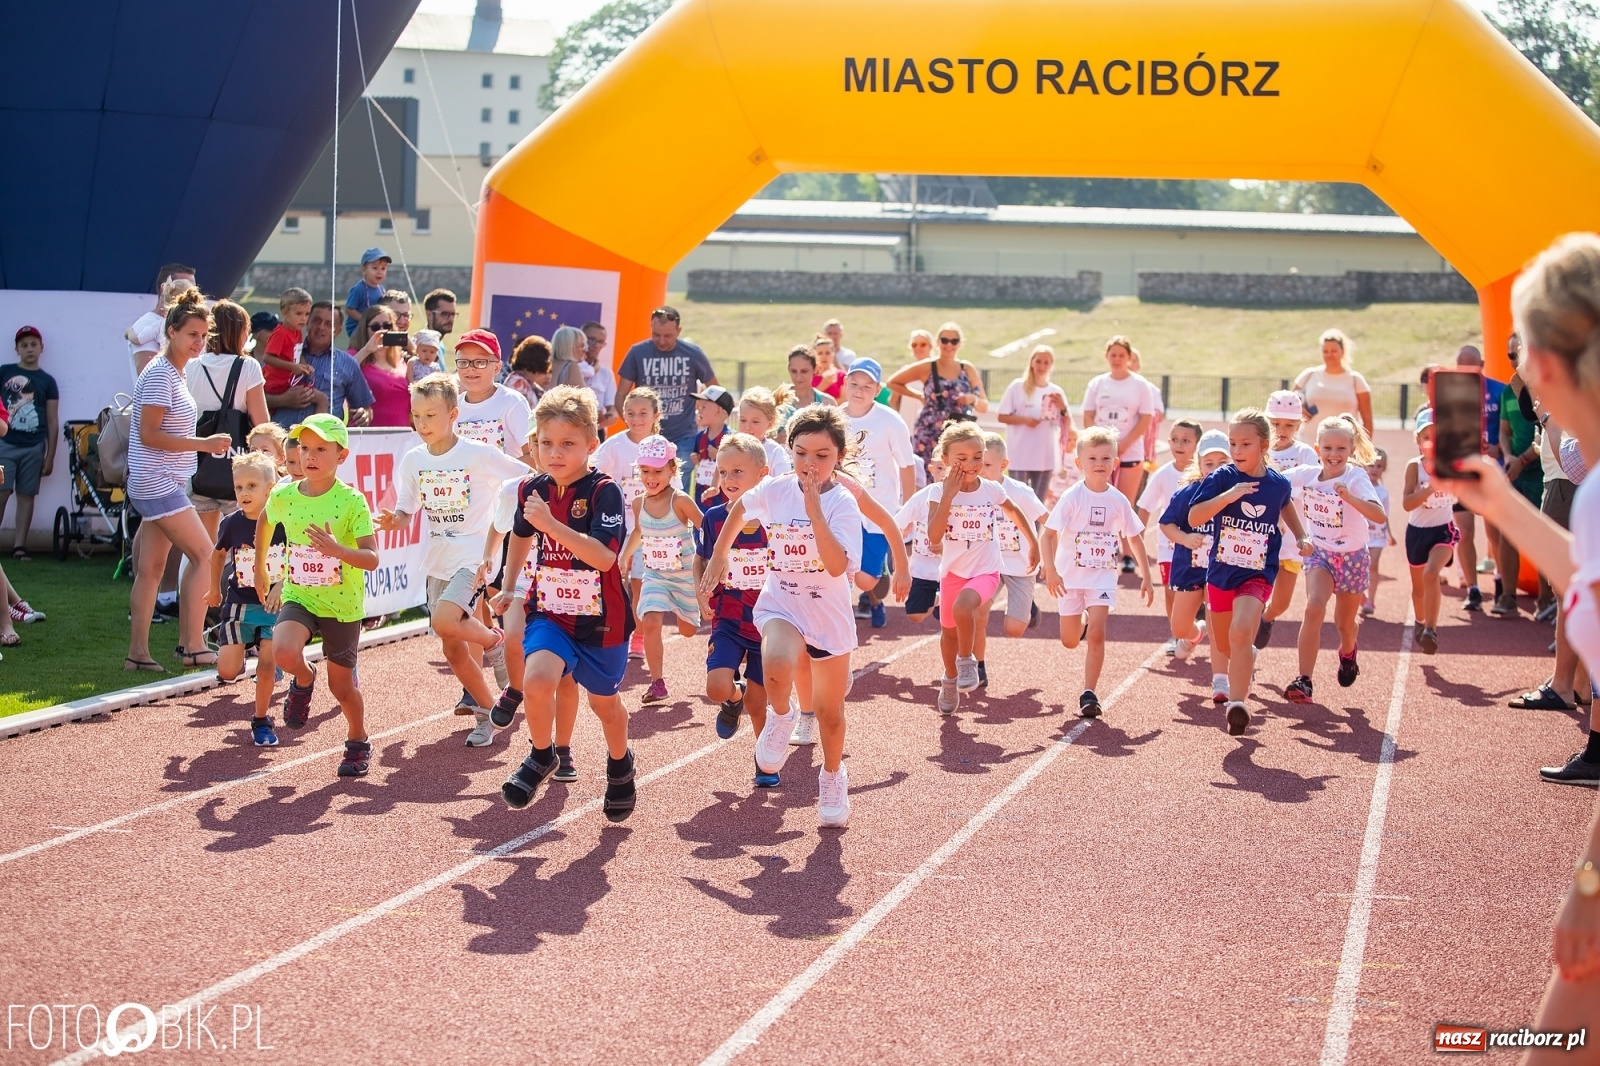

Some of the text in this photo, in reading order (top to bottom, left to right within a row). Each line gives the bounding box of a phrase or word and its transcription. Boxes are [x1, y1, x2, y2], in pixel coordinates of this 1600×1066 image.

[844, 52, 1280, 97] MIASTO RACIBÓRZ
[643, 357, 690, 376] VENICE
[433, 487, 452, 497] 047
[1314, 503, 1330, 514] 026
[442, 514, 465, 523] KIDS
[962, 520, 981, 530] 020
[1221, 515, 1276, 535] FRUTAVITA
[652, 550, 668, 559] 083
[783, 544, 807, 556] 040
[1090, 547, 1106, 557] 199
[1233, 543, 1253, 556] 006
[302, 562, 325, 573] 082
[742, 565, 766, 576] 055
[556, 587, 582, 600] 052
